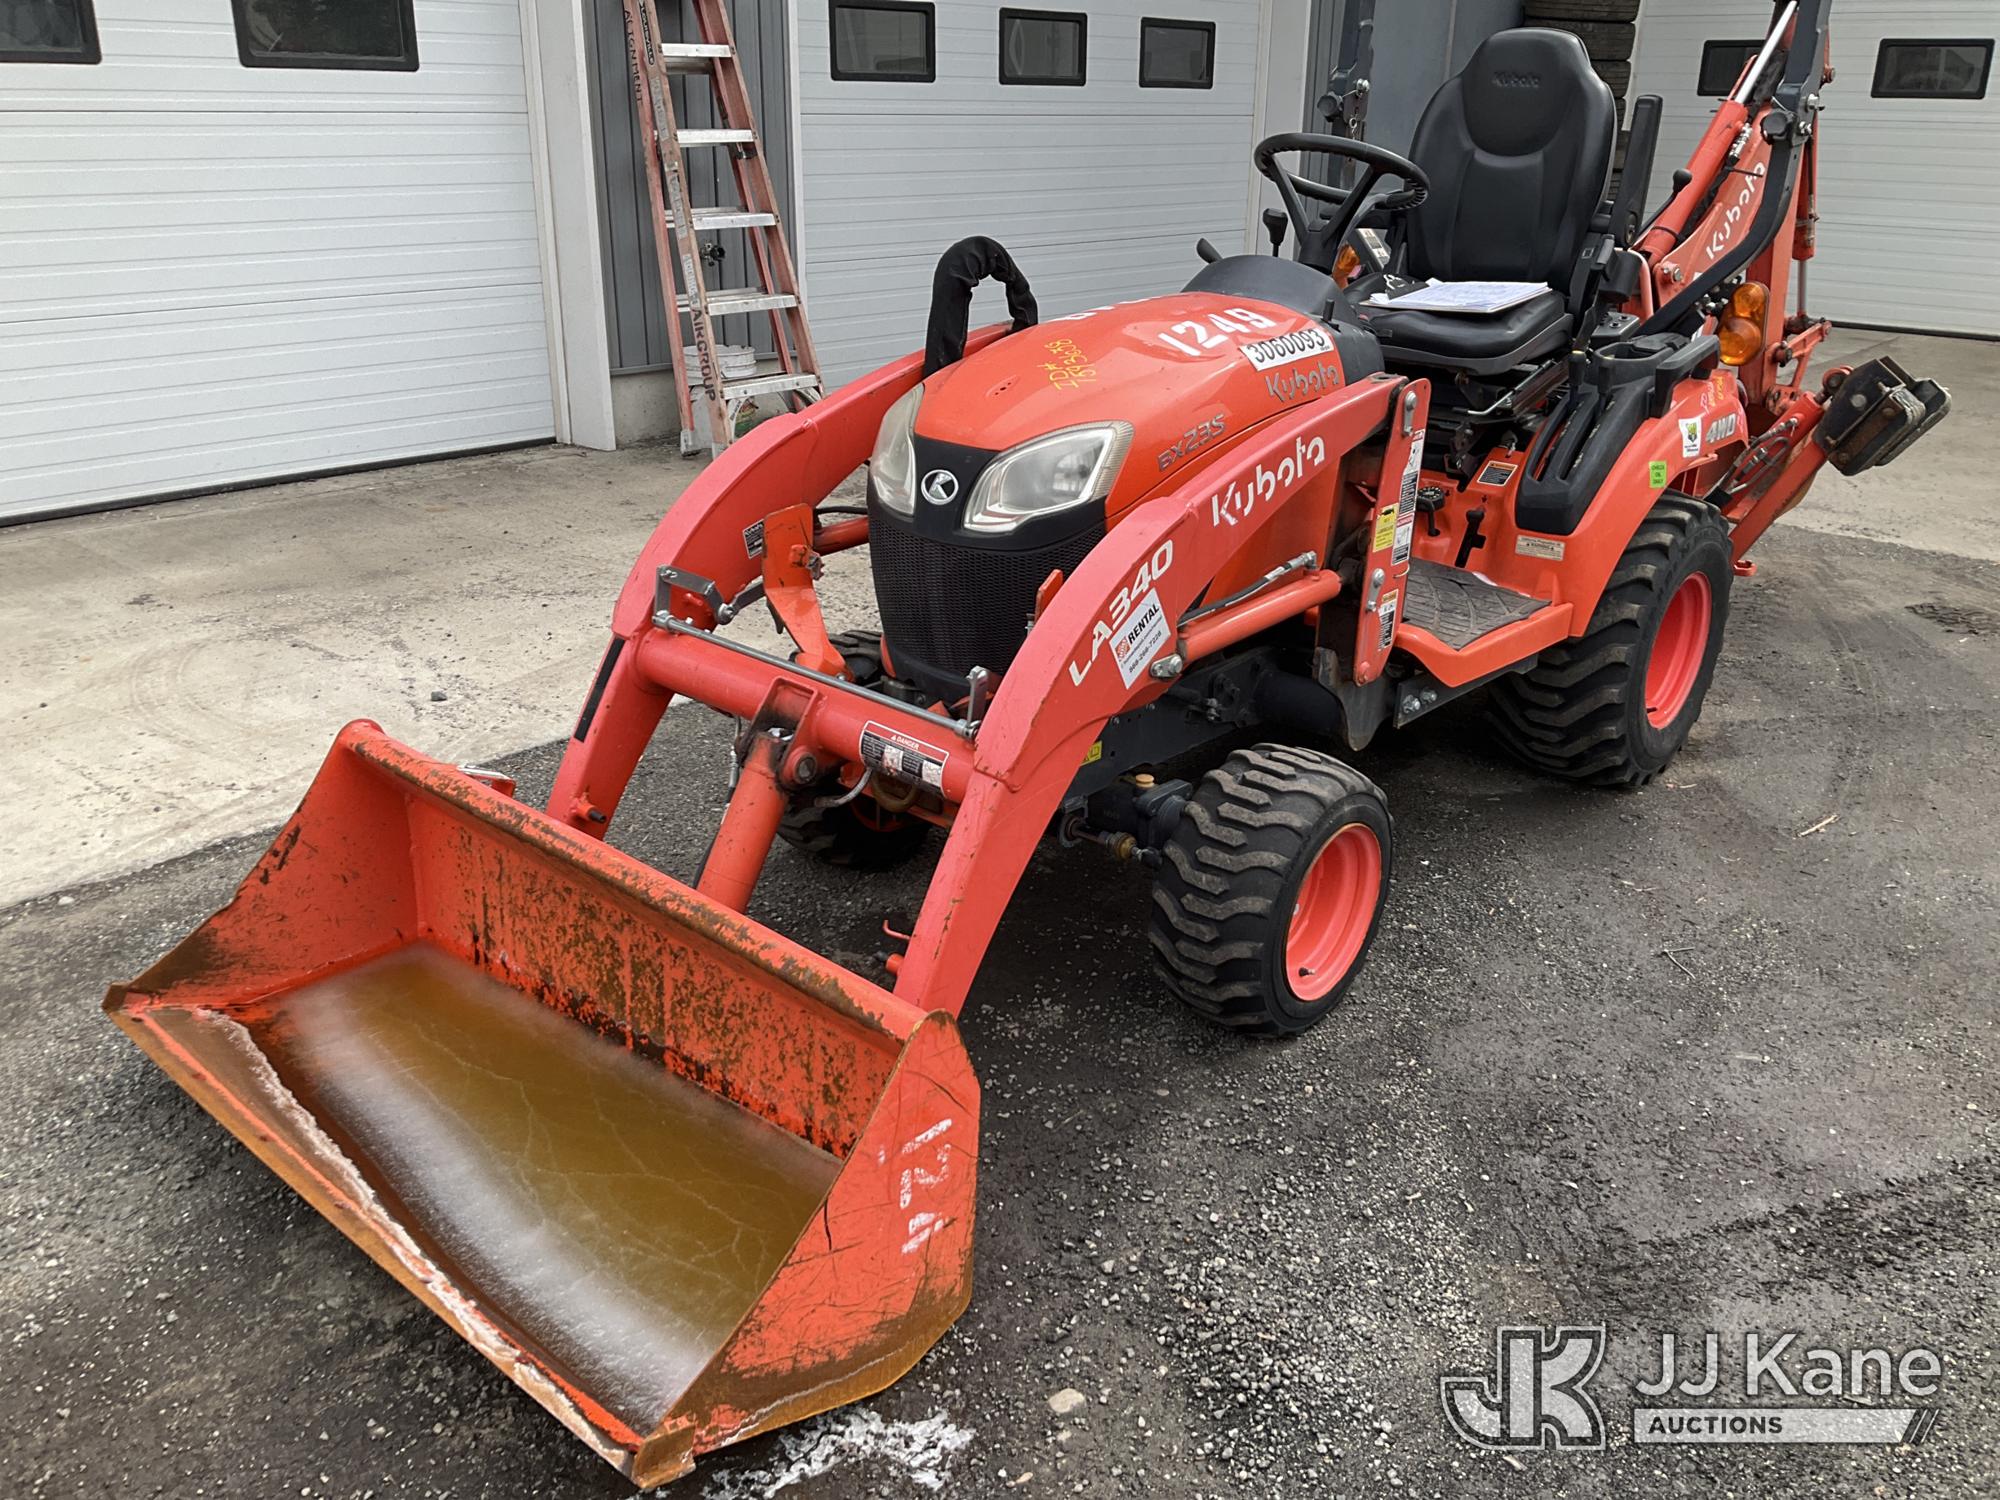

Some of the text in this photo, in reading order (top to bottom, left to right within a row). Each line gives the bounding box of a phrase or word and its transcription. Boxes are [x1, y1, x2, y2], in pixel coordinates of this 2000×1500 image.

[1706, 161, 1766, 260] Kubota
[1158, 307, 1277, 356] 1249
[1247, 328, 1326, 363] 3060093
[1265, 360, 1340, 403] Kubota
[1706, 412, 1737, 444] 4WD
[1211, 436, 1326, 528] Kubota
[1069, 539, 1174, 687] LA340
[1127, 603, 1160, 645] RENTAL
[896, 735, 920, 751] DANGER
